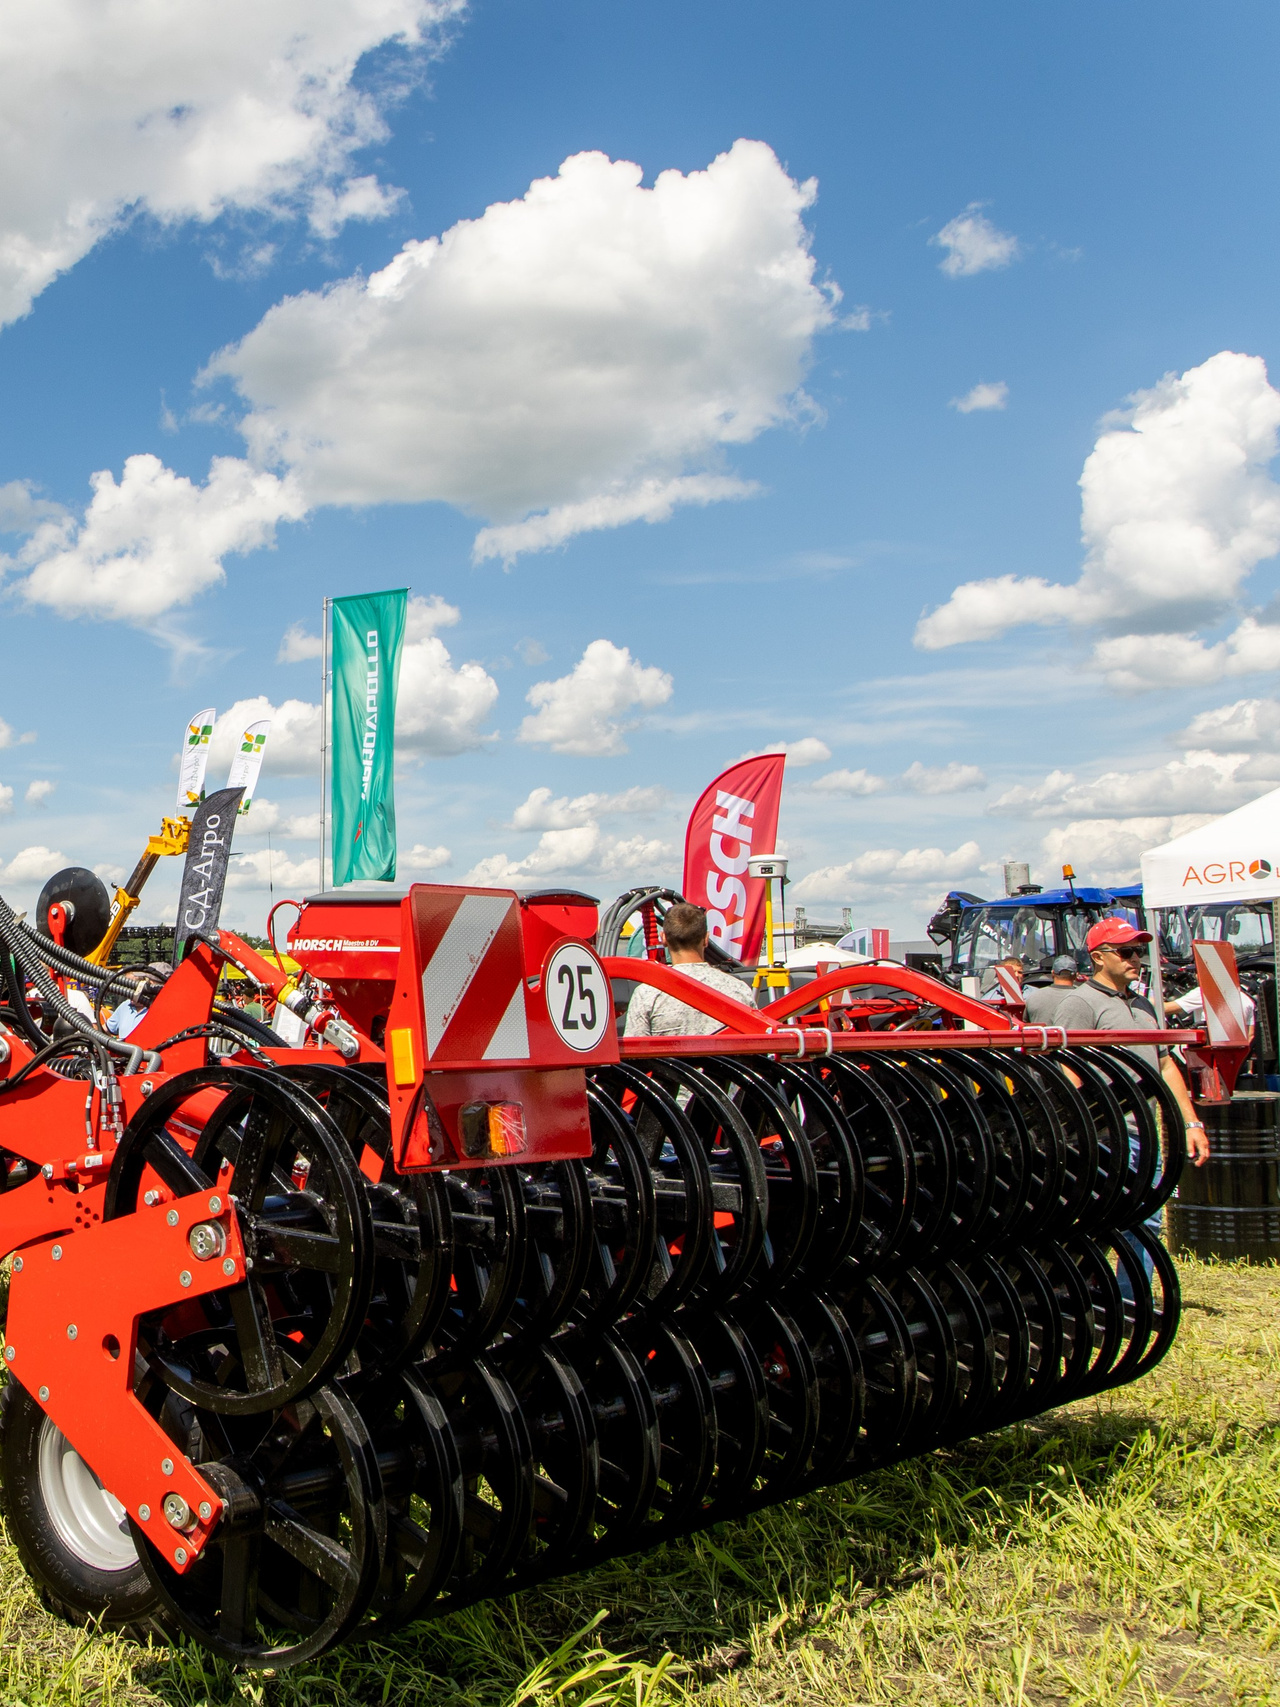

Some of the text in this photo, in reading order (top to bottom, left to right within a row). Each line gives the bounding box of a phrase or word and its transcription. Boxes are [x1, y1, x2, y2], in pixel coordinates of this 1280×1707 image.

[185, 814, 224, 930] СД-Агро
[706, 789, 756, 960] RSCH
[294, 939, 343, 951] HORSCH
[557, 964, 597, 1030] 25
